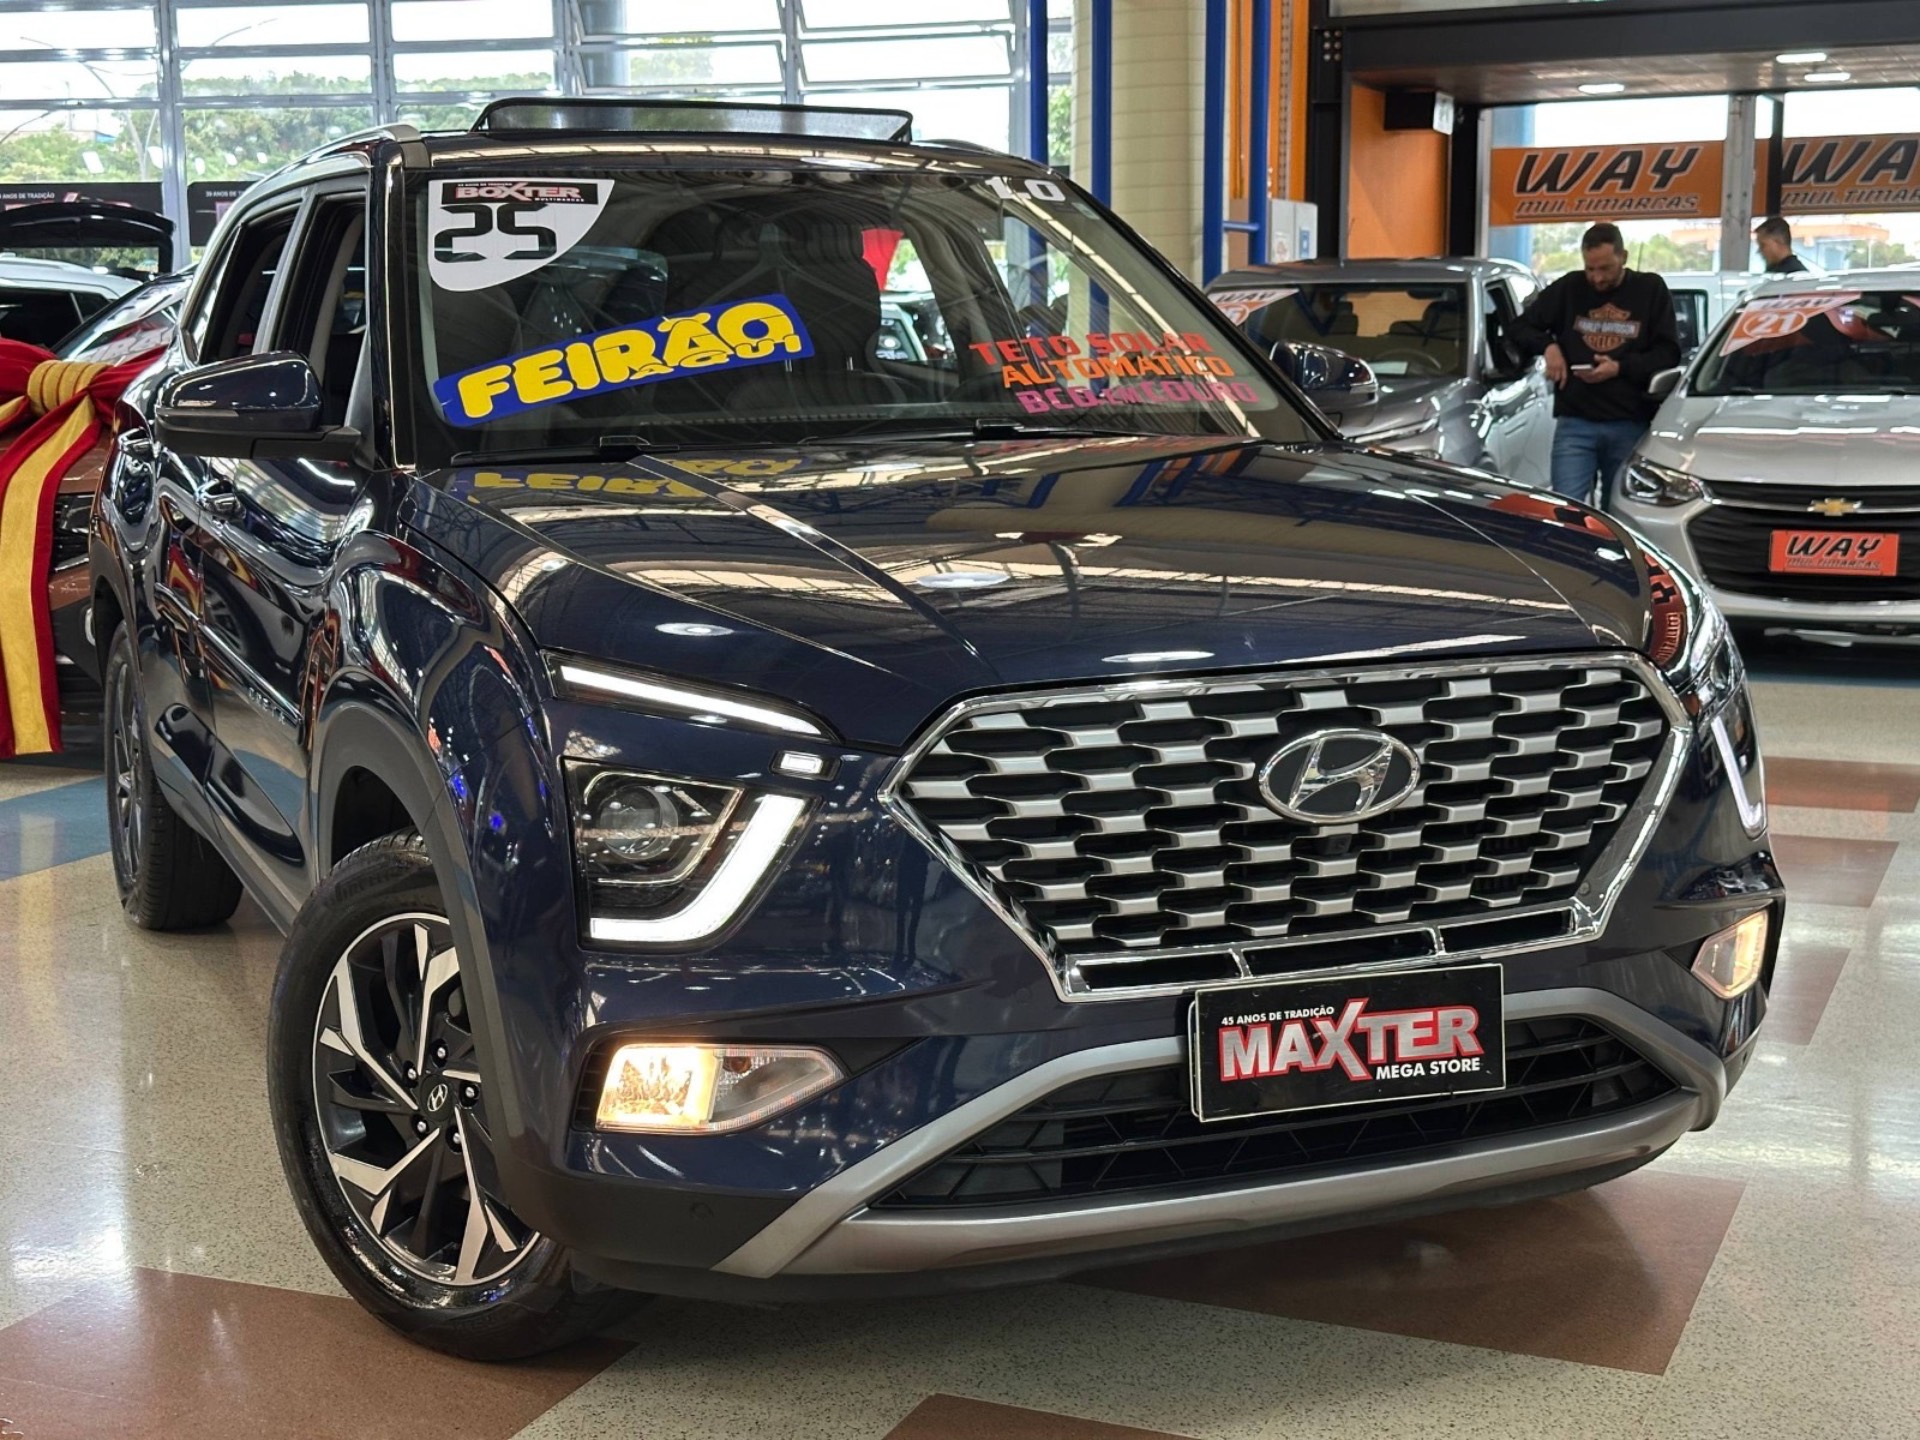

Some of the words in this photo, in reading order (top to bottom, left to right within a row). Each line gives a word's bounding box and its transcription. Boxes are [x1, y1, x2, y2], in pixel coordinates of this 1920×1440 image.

[1515, 146, 1702, 195] WAY
[456, 182, 581, 202] BOXTER
[434, 203, 557, 263] 25
[1753, 313, 1796, 335] 21
[457, 302, 796, 419] FEIRÃO
[969, 335, 1082, 366] TETO
[1086, 332, 1214, 354] SOLAR
[1143, 380, 1260, 403] COURO
[1787, 535, 1881, 558] WAY
[1221, 1017, 1234, 1025] 45
[1236, 1013, 1266, 1025] ANOS
[1269, 1011, 1282, 1021] DE
[1284, 1004, 1335, 1019] TRADIÇÃO
[1218, 997, 1485, 1082] MAXTER
[1376, 1062, 1426, 1080] MEGA
[1429, 1057, 1481, 1075] STORE
